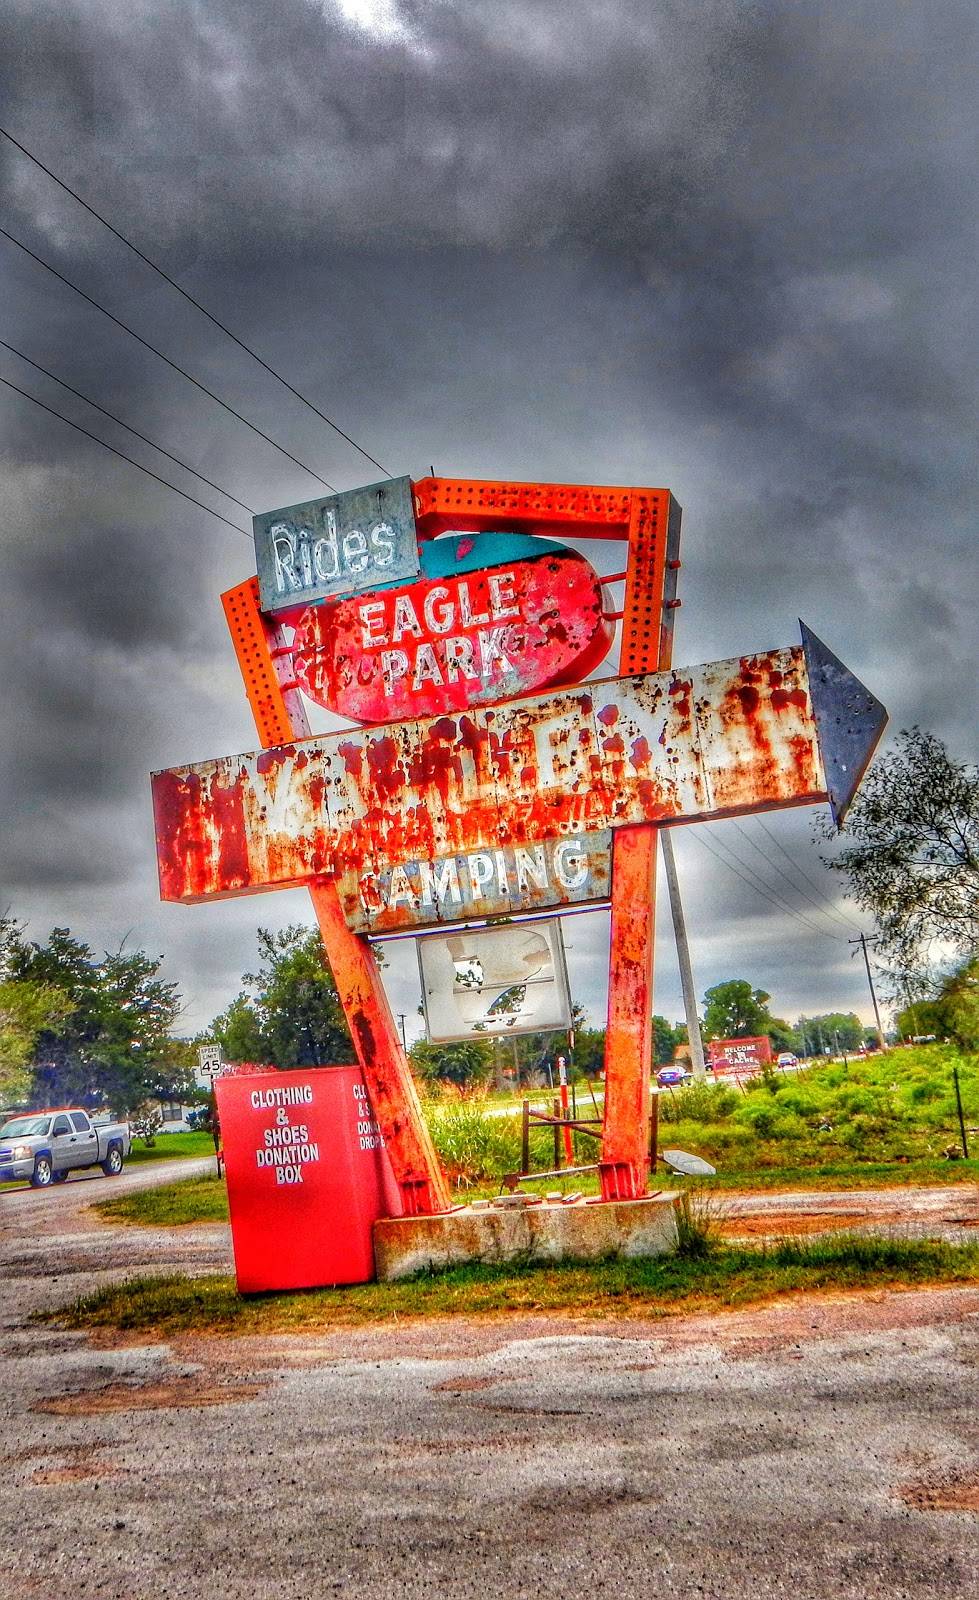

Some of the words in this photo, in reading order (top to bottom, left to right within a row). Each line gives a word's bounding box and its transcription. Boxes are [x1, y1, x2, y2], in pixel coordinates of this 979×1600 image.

[271, 509, 396, 592] Rides
[359, 572, 520, 648] EAGLE
[381, 627, 514, 697] PARK
[359, 840, 590, 915] CAMPING
[724, 1045, 756, 1053] WELCOME
[202, 1060, 220, 1071] 45
[251, 1085, 313, 1108] CLOTHING
[276, 1107, 289, 1125] &
[264, 1125, 308, 1147] SHOES
[256, 1143, 319, 1167] DONATION
[276, 1165, 303, 1184] BOX
